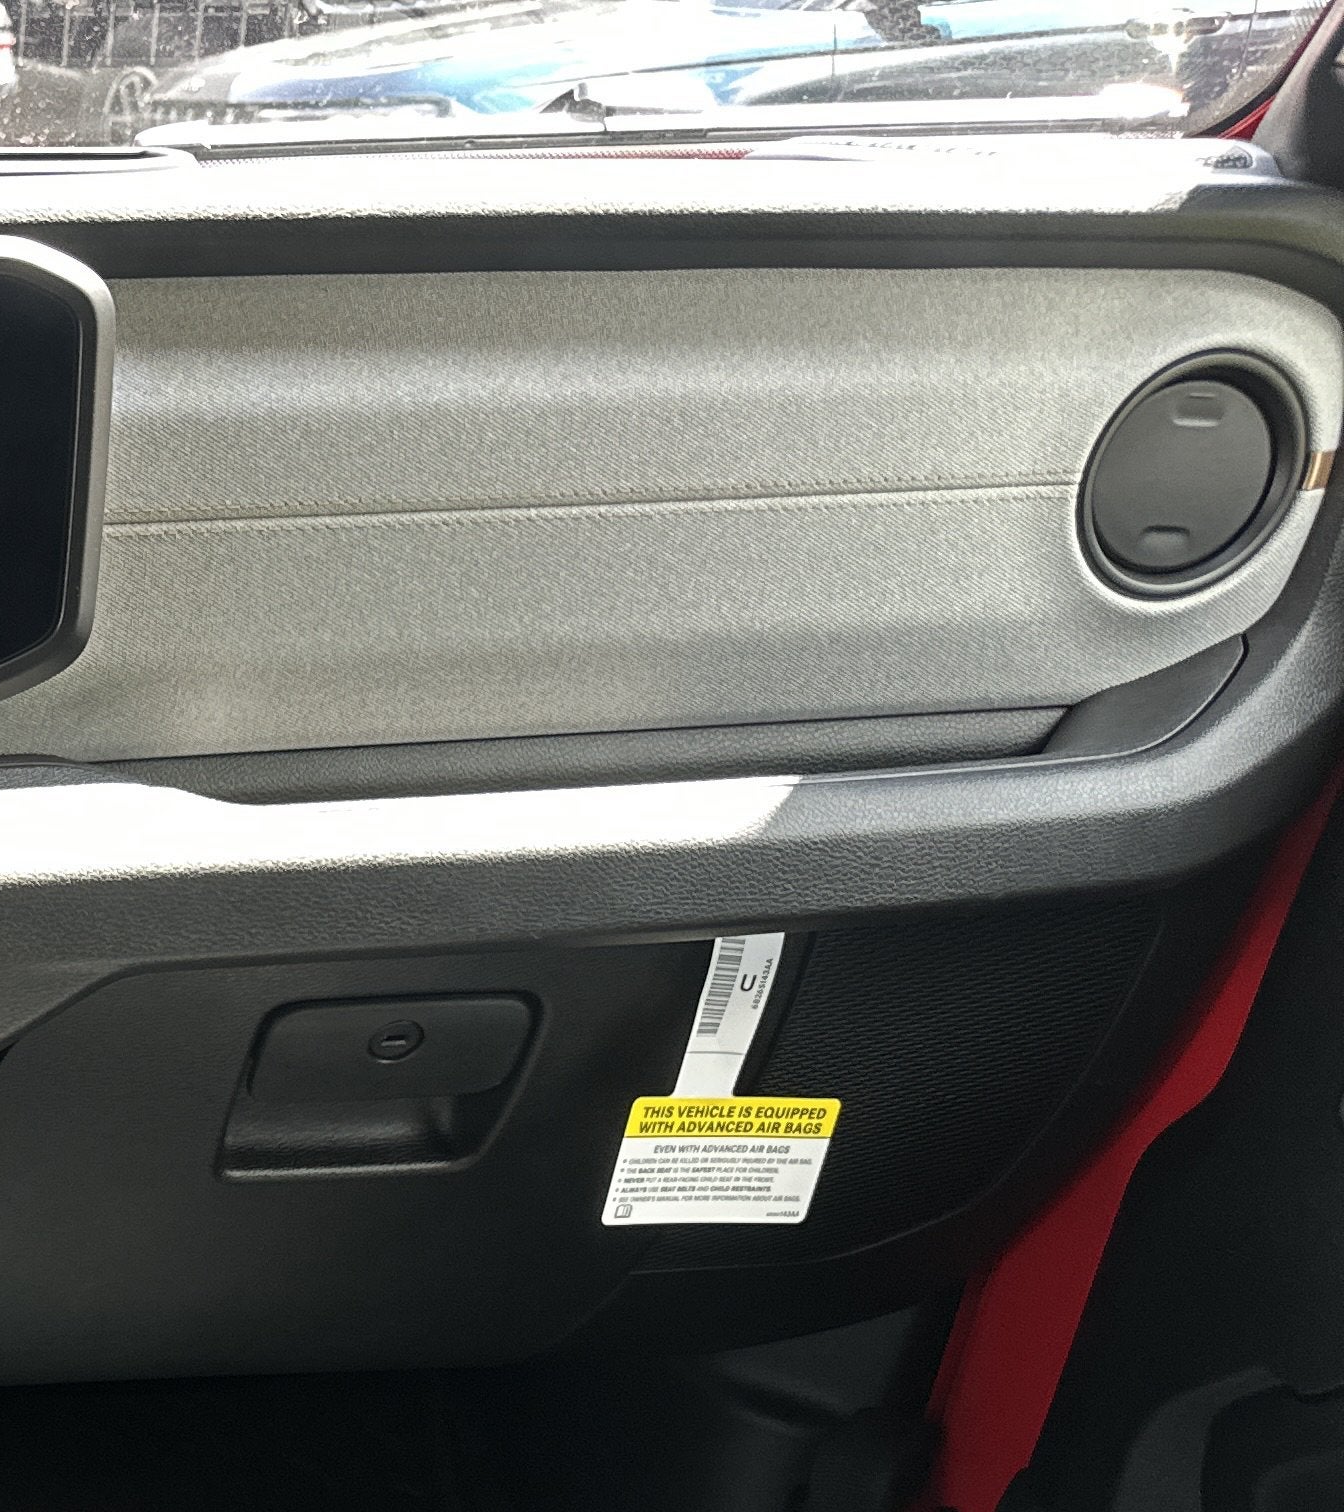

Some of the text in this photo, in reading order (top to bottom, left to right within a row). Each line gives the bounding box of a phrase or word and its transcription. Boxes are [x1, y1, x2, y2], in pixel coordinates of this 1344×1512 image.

[740, 973, 758, 992] U
[643, 1105, 828, 1120] THIS VEHICLE IS EQUIPPED
[638, 1120, 823, 1135] WITH ADVANCED AIR BAGS
[653, 1144, 791, 1155] EVEN WITH ADVANCED AIR BAGS
